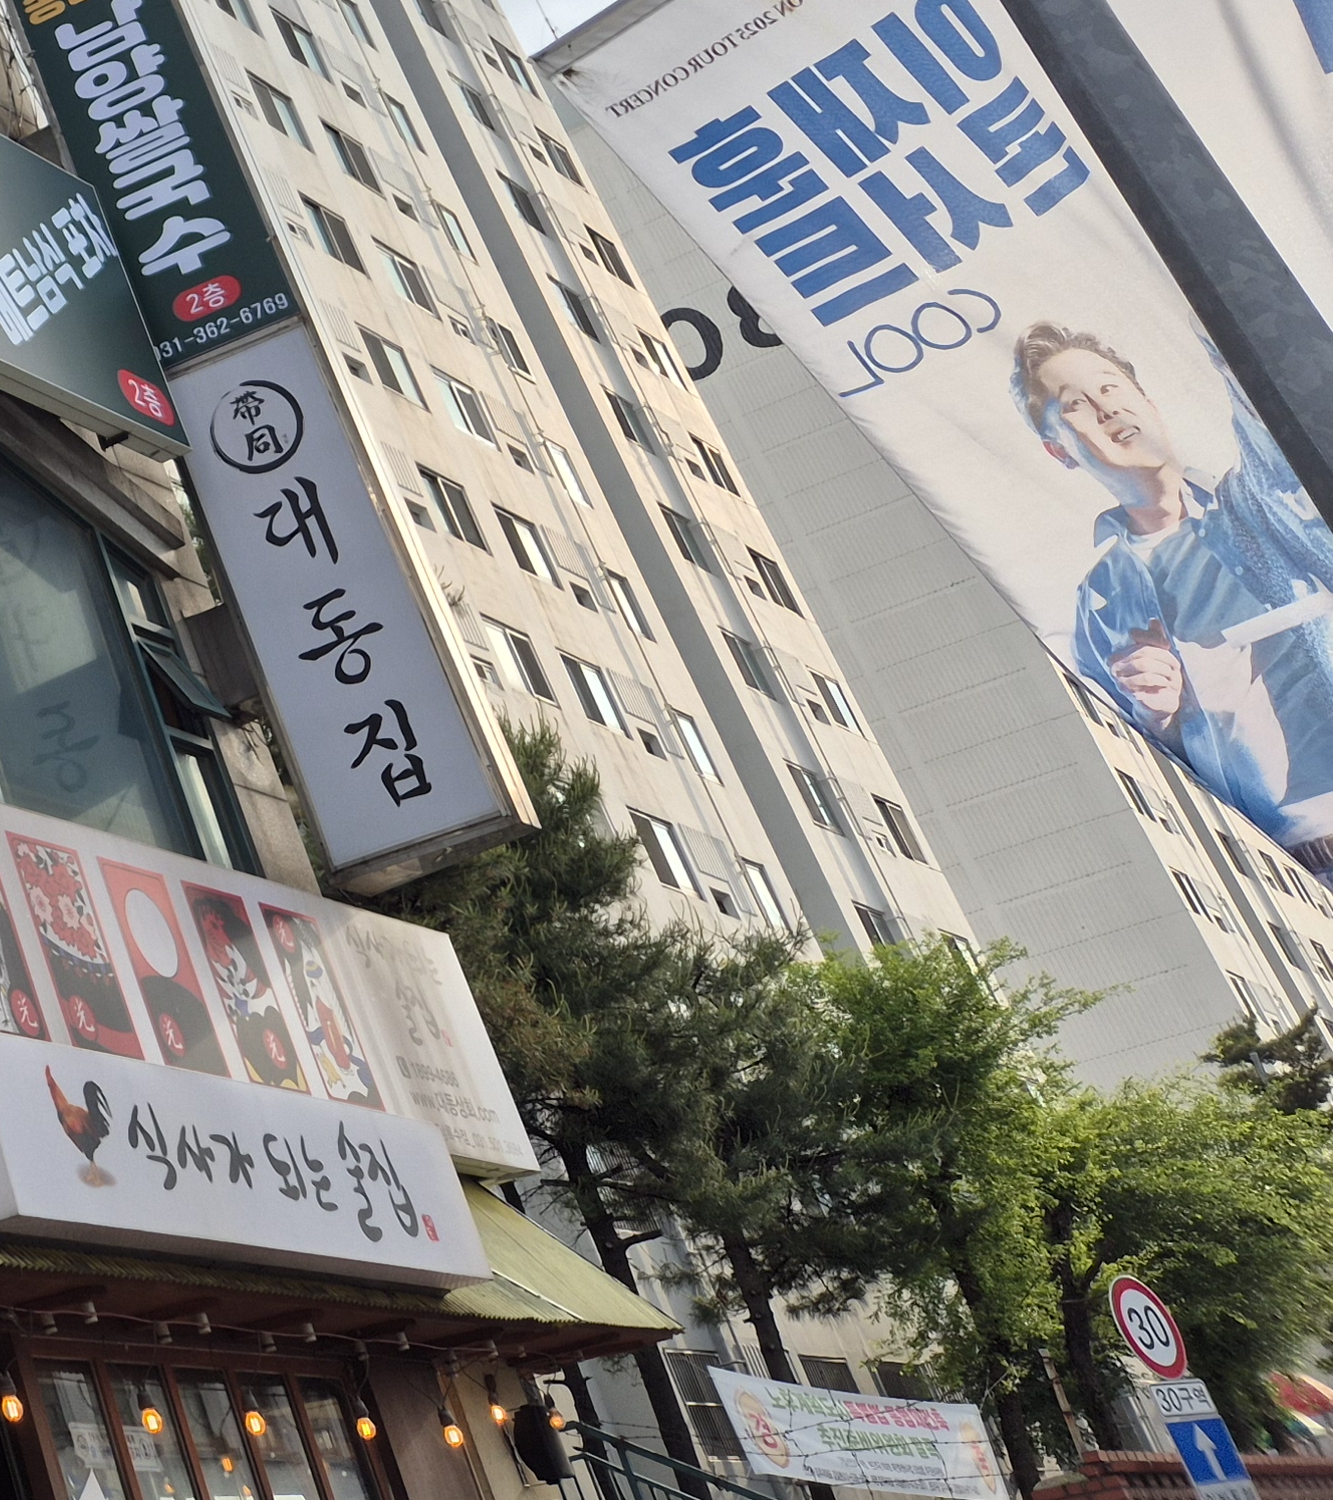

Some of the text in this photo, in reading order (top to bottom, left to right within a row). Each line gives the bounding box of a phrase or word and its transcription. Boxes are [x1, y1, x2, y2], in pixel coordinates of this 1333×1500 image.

[52, 193, 118, 278] 포차
[186, 284, 226, 314] 2층
[128, 378, 165, 419] 2층
[253, 475, 432, 806] 대동집
[18, 994, 38, 1029] 光
[75, 1000, 95, 1032] 光
[162, 1016, 183, 1050] 光
[267, 1033, 286, 1063] 光
[128, 1101, 419, 1243] 식사가 되는 술집
[1127, 1304, 1171, 1350] 30
[1156, 1386, 1212, 1413] 30구역
